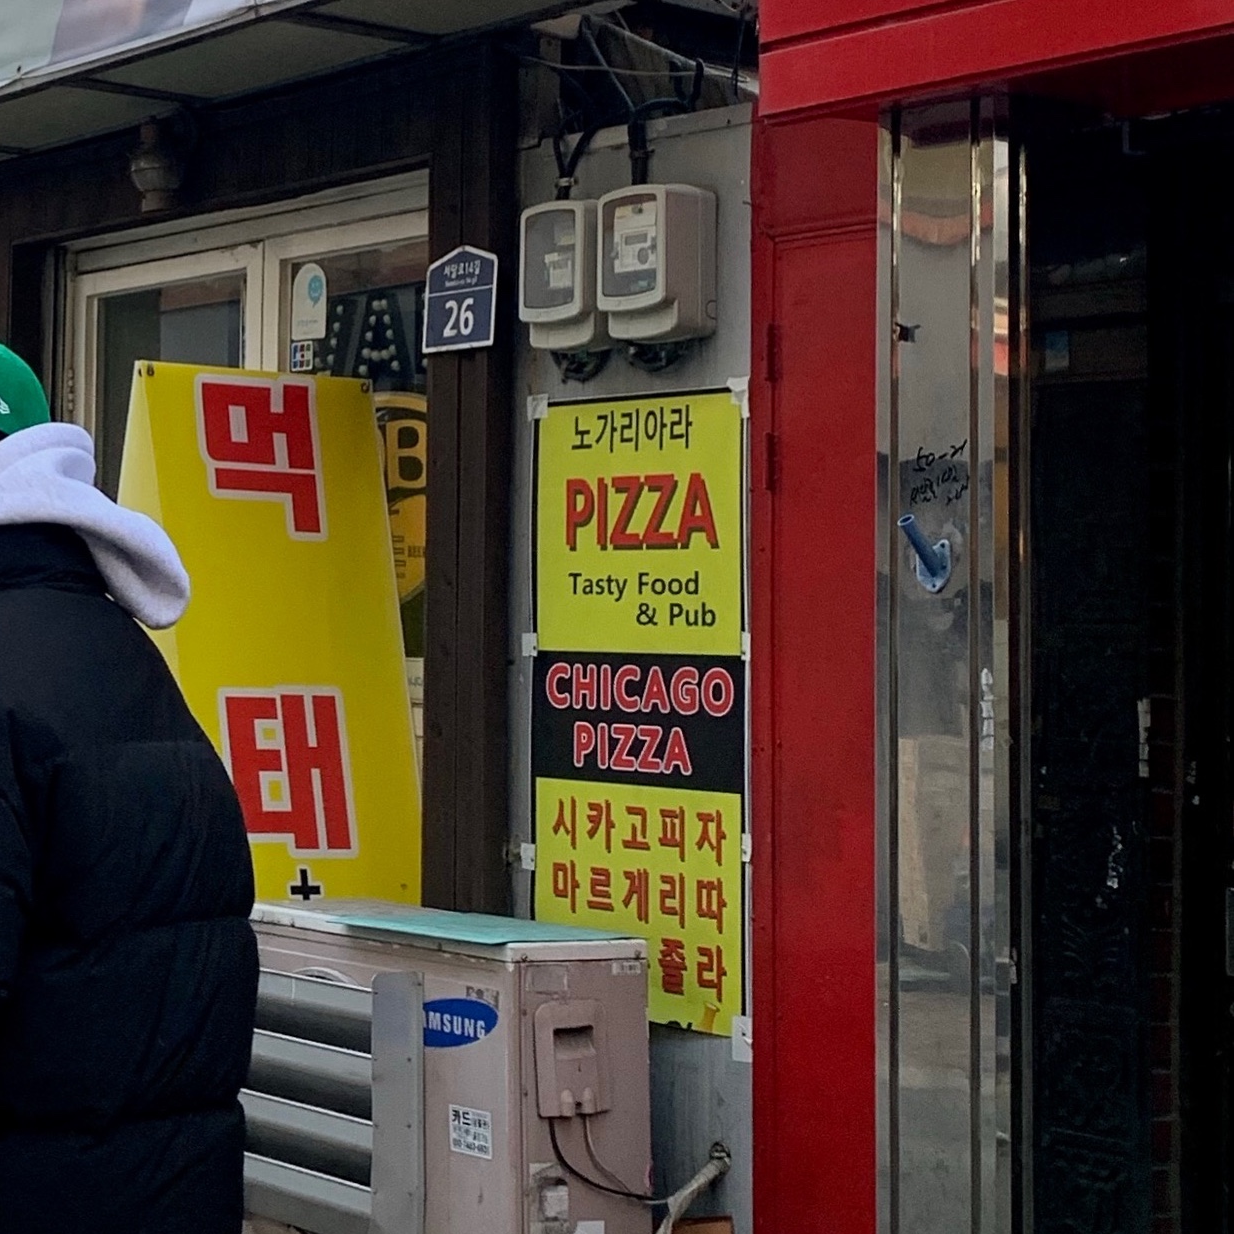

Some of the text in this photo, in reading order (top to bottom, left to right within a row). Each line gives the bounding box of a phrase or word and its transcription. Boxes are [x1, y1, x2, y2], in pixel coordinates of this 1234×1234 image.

[443, 297, 474, 338] 26
[572, 403, 693, 453] 노가리아라
[565, 472, 720, 551] PIZZA
[568, 571, 699, 602] Tasty Food
[636, 602, 716, 627] & Pub
[546, 662, 734, 717] CHICAGO
[573, 721, 692, 775] PIZZA
[552, 796, 726, 867] 시카고피자
[552, 859, 727, 934] 마르게리따
[424, 1009, 486, 1039] MSUNG
